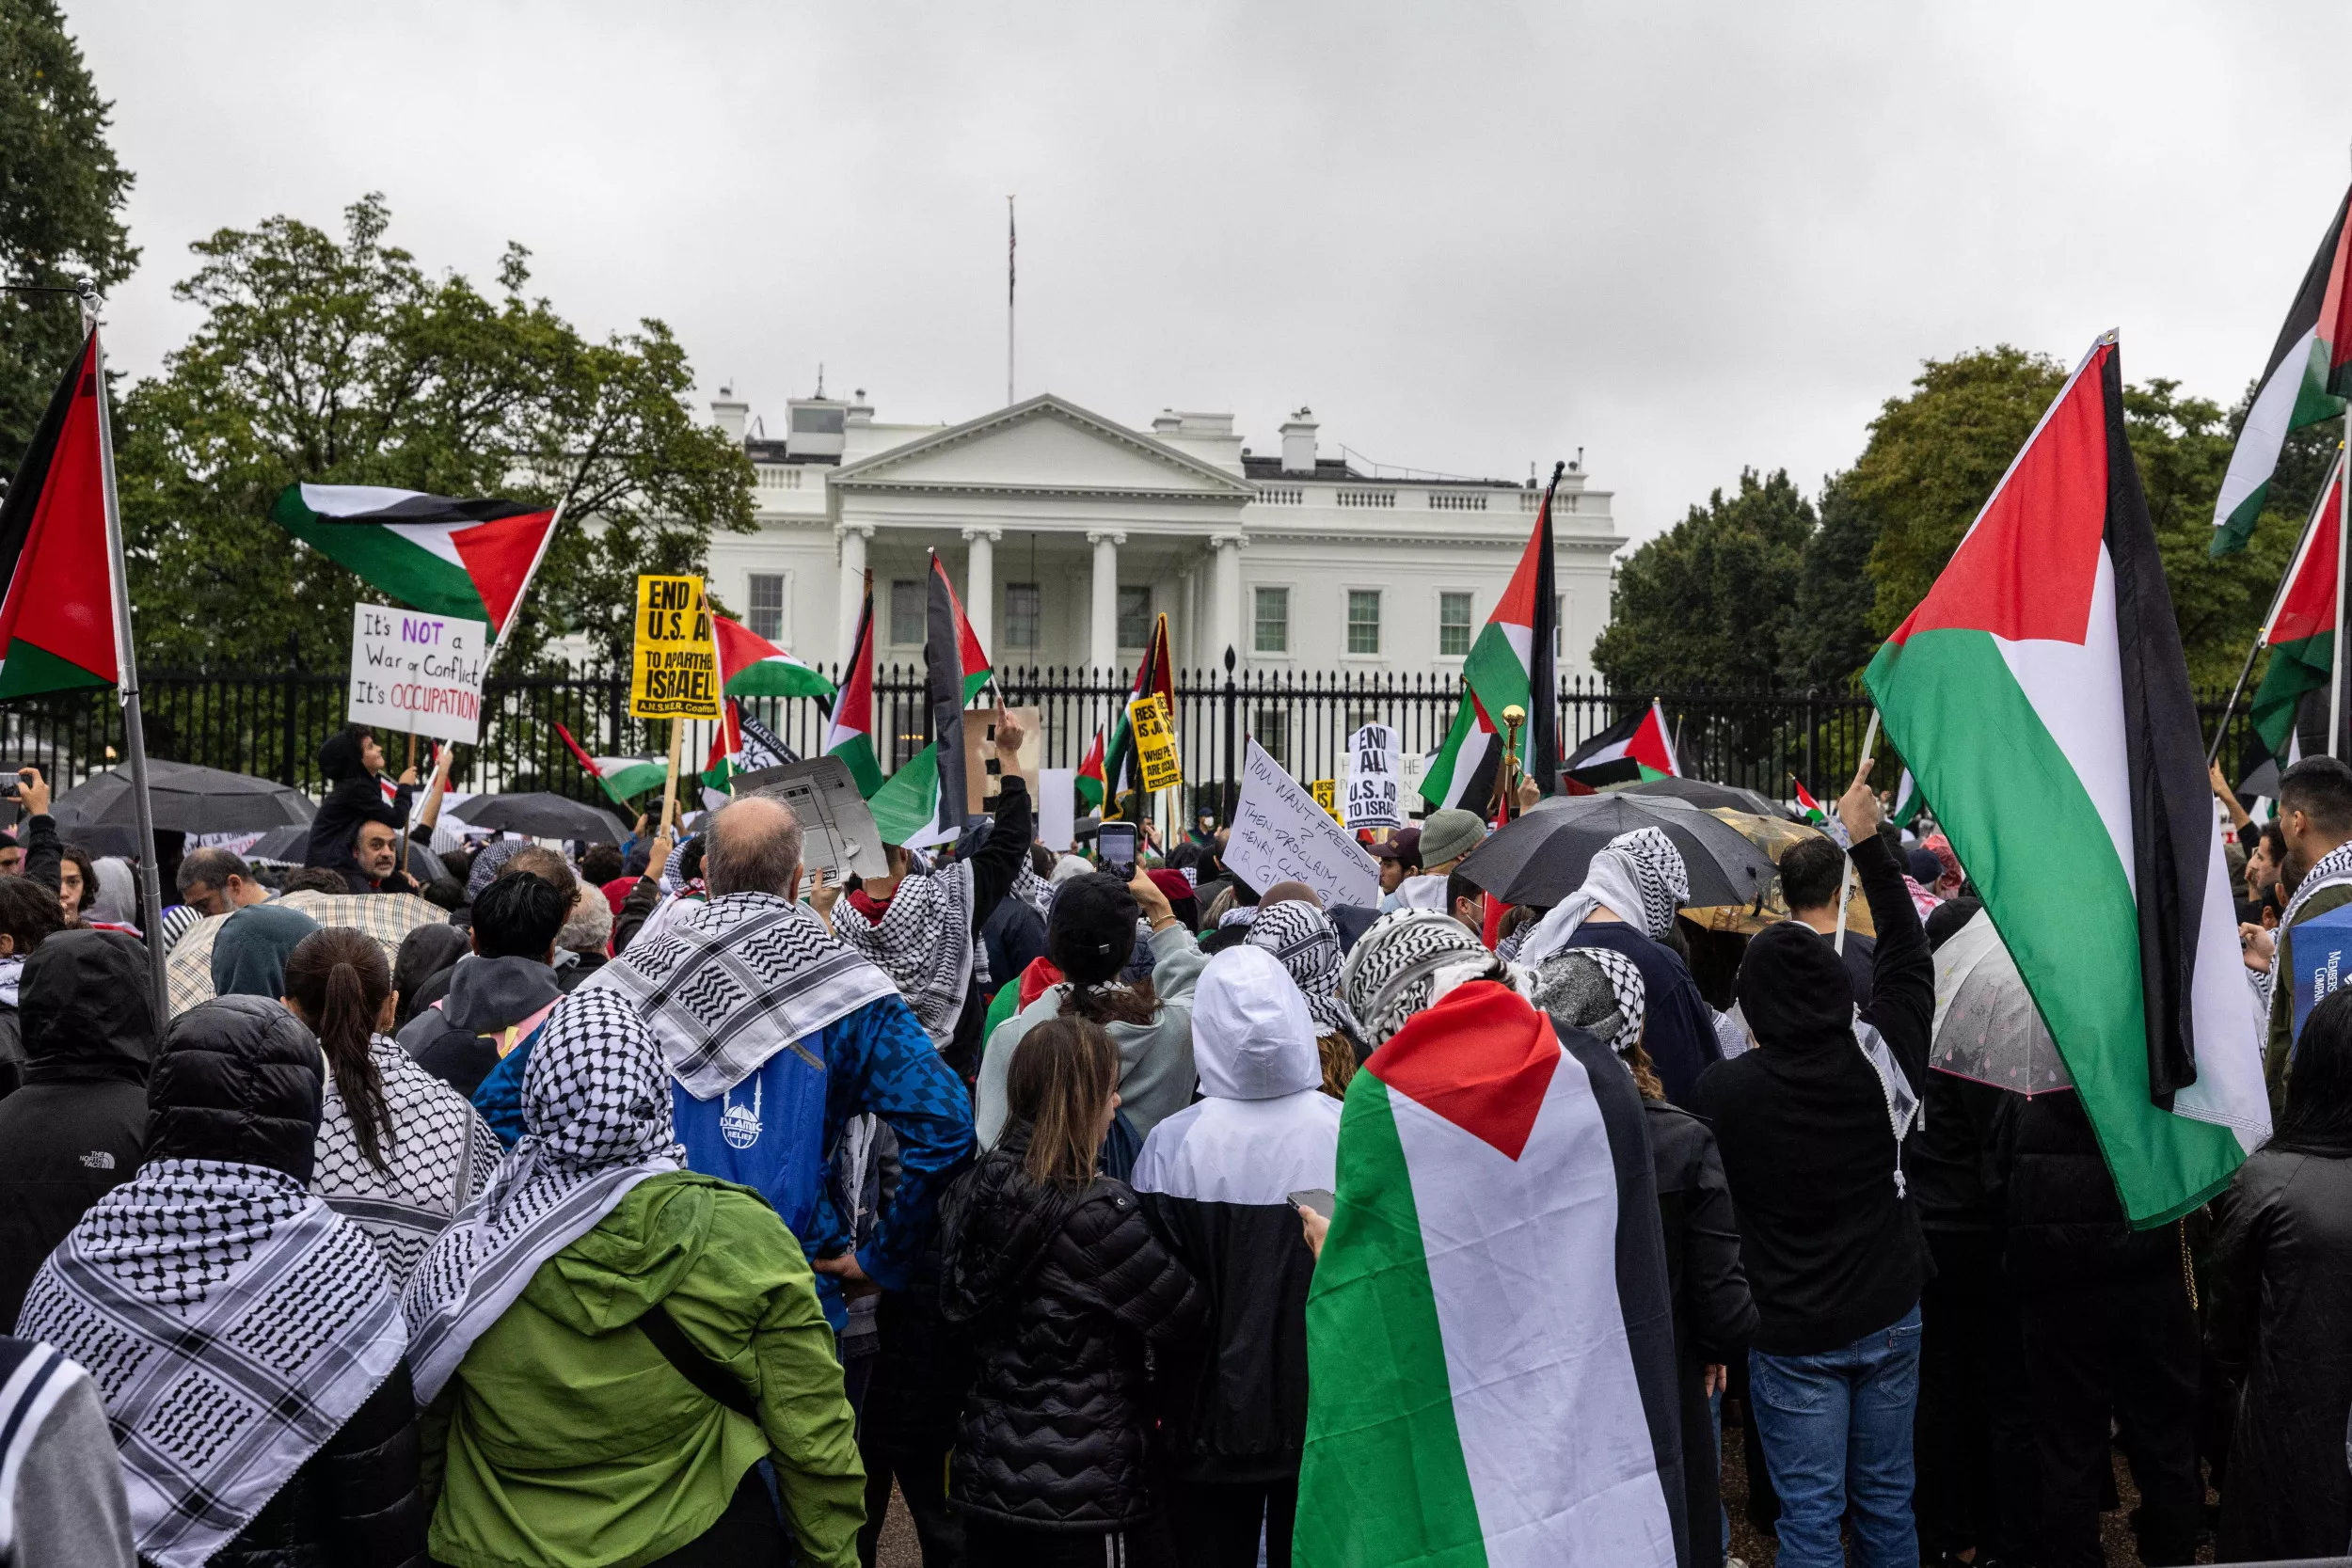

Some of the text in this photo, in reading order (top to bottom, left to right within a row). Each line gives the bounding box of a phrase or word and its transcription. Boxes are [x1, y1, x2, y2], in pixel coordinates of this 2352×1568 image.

[649, 580, 690, 610] END
[364, 613, 462, 649] It's NOT a
[648, 610, 685, 640] U.S.
[366, 643, 478, 687] War or Conflict
[645, 651, 660, 668] TO
[356, 681, 479, 721] It's OCCUPATION
[1137, 723, 1149, 738] IS
[1359, 727, 1387, 752] END
[1360, 751, 1388, 774] ALL
[1249, 752, 1272, 785] YOU
[1275, 778, 1315, 821] WANT
[1317, 792, 1328, 809] IS
[1350, 780, 1379, 802] U.S.
[1242, 800, 1274, 832] THEN
[1348, 802, 1361, 817] TO
[1233, 847, 1251, 873] OR
[1242, 829, 1274, 863] HENRY
[1278, 858, 1308, 883] CLAY
[2328, 950, 2342, 992] MEMBERS
[2314, 967, 2328, 1006] COMPAN
[720, 1117, 763, 1132] ISLAMIC
[727, 1131, 753, 1141] RELIEF
